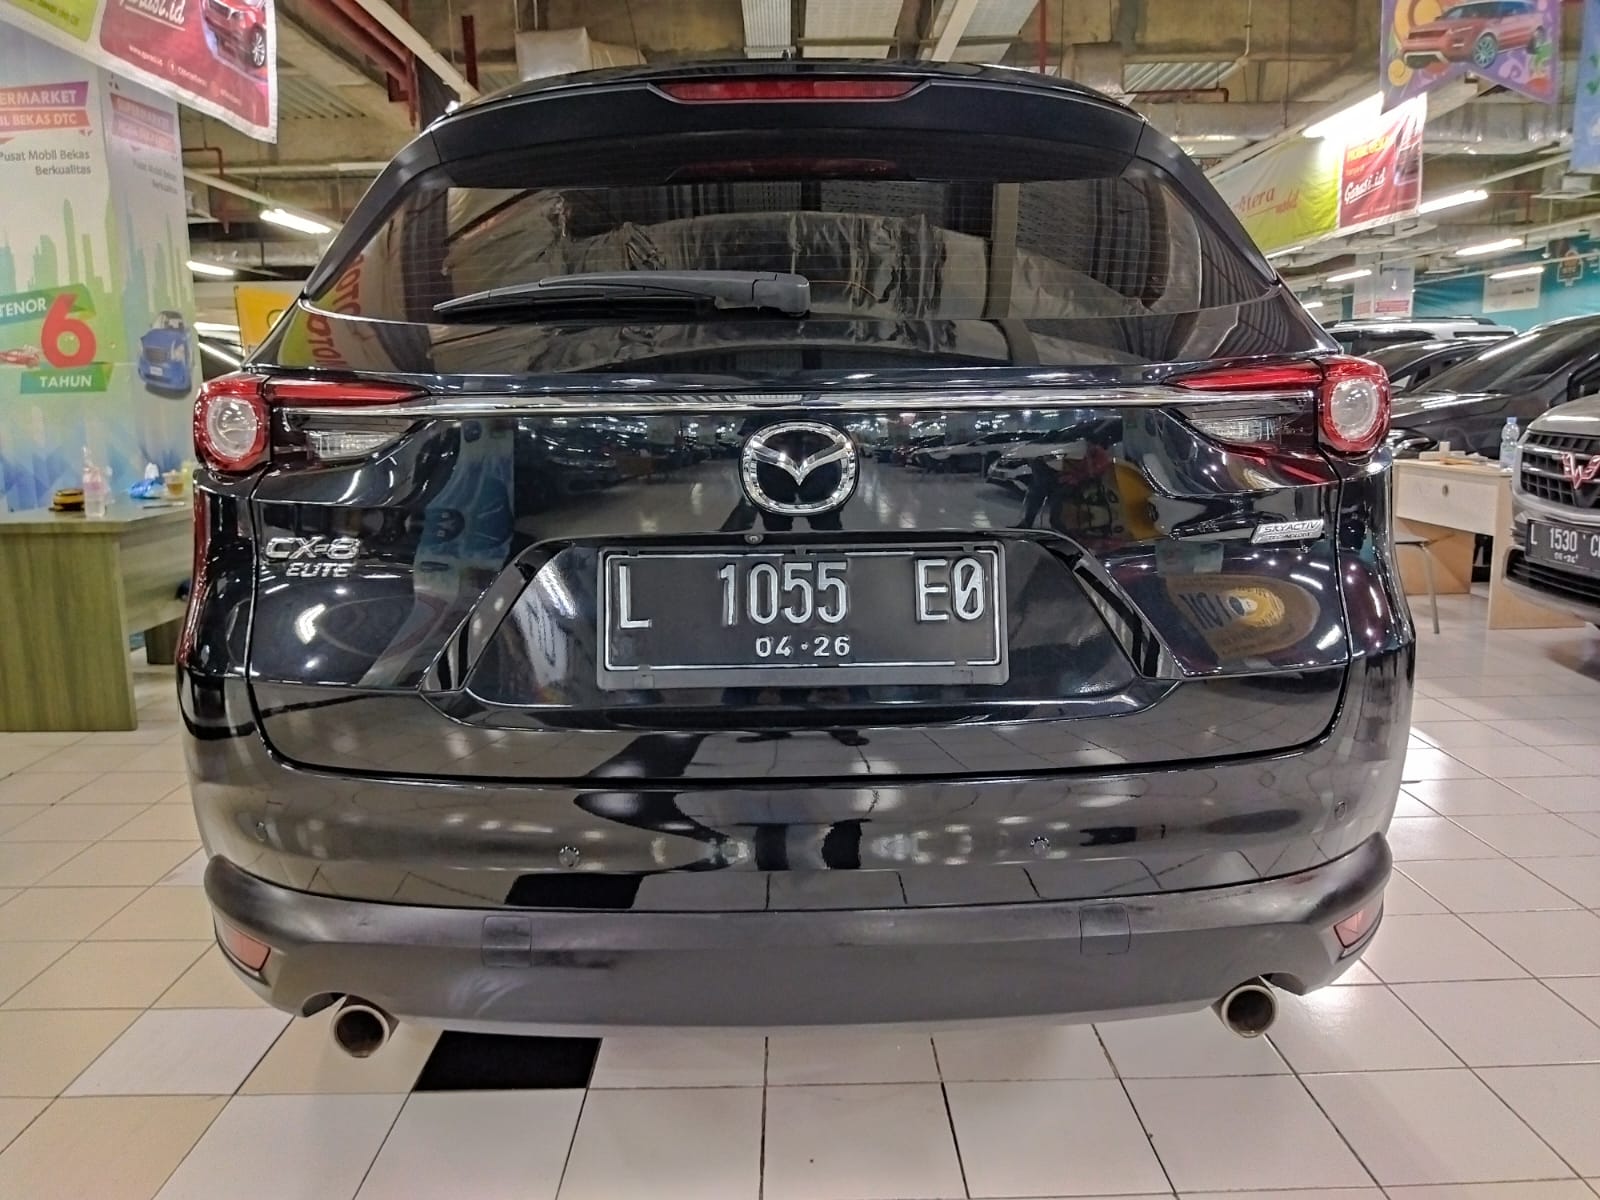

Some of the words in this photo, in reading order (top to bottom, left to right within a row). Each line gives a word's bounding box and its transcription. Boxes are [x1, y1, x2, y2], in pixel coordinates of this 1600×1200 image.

[12, 113, 50, 126] BEKAS
[54, 112, 78, 125] DTC
[28, 149, 57, 160] Mobil
[60, 148, 90, 160] Bekas
[35, 164, 91, 176] Berkualitas
[41, 292, 97, 369] 6
[40, 375, 92, 388] TAHUN
[265, 536, 361, 560] CX-8
[1530, 524, 1538, 545] L
[1549, 527, 1578, 553] 1530
[1590, 534, 1600, 558] C
[618, 564, 652, 629] L
[718, 561, 848, 626] 1055
